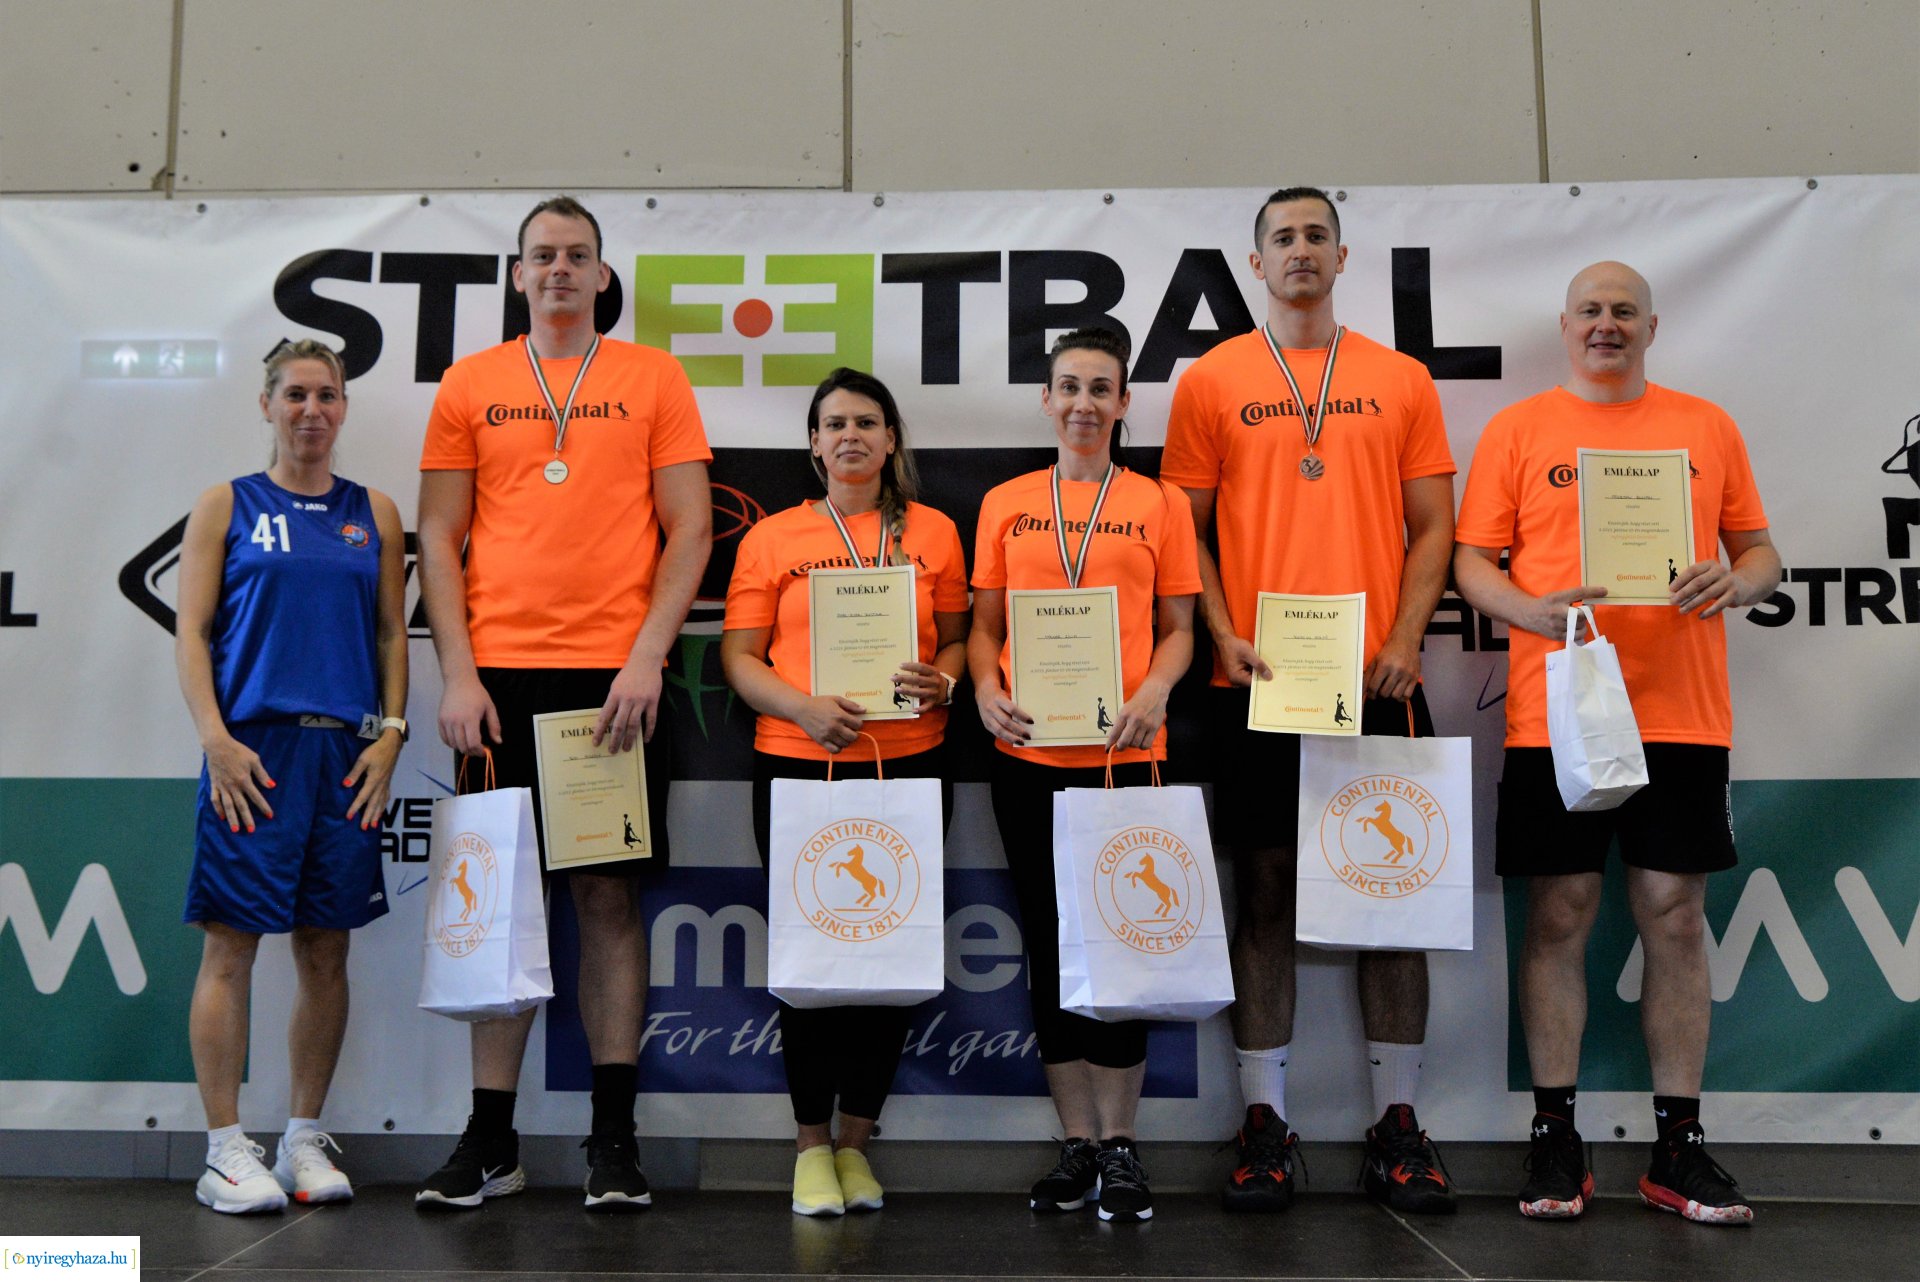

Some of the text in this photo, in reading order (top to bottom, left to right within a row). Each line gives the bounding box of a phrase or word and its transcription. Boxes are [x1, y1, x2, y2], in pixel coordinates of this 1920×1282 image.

[263, 246, 1502, 388] STEETBAL
[486, 402, 609, 427] Continntal
[1240, 397, 1363, 427] Contietal
[1604, 466, 1660, 477] EMLÉKLAP
[304, 503, 328, 511] JAKO
[251, 513, 291, 552] 41
[836, 584, 889, 596] EMLÉKLAP
[1036, 605, 1091, 617] EMLÉKLAP
[1284, 609, 1339, 620] EMLÉKLAP
[1331, 779, 1438, 822] CONTINENTAL
[804, 823, 910, 864] CONTINENTAL
[1100, 831, 1193, 875] CONTINENTAL
[1340, 864, 1430, 894] SINCE 1871
[438, 921, 486, 954] SINCE 1871
[812, 910, 901, 938] SINCE 1871
[1117, 919, 1195, 950] SINCE 1871
[639, 1011, 724, 1055] For
[728, 1009, 784, 1056] th
